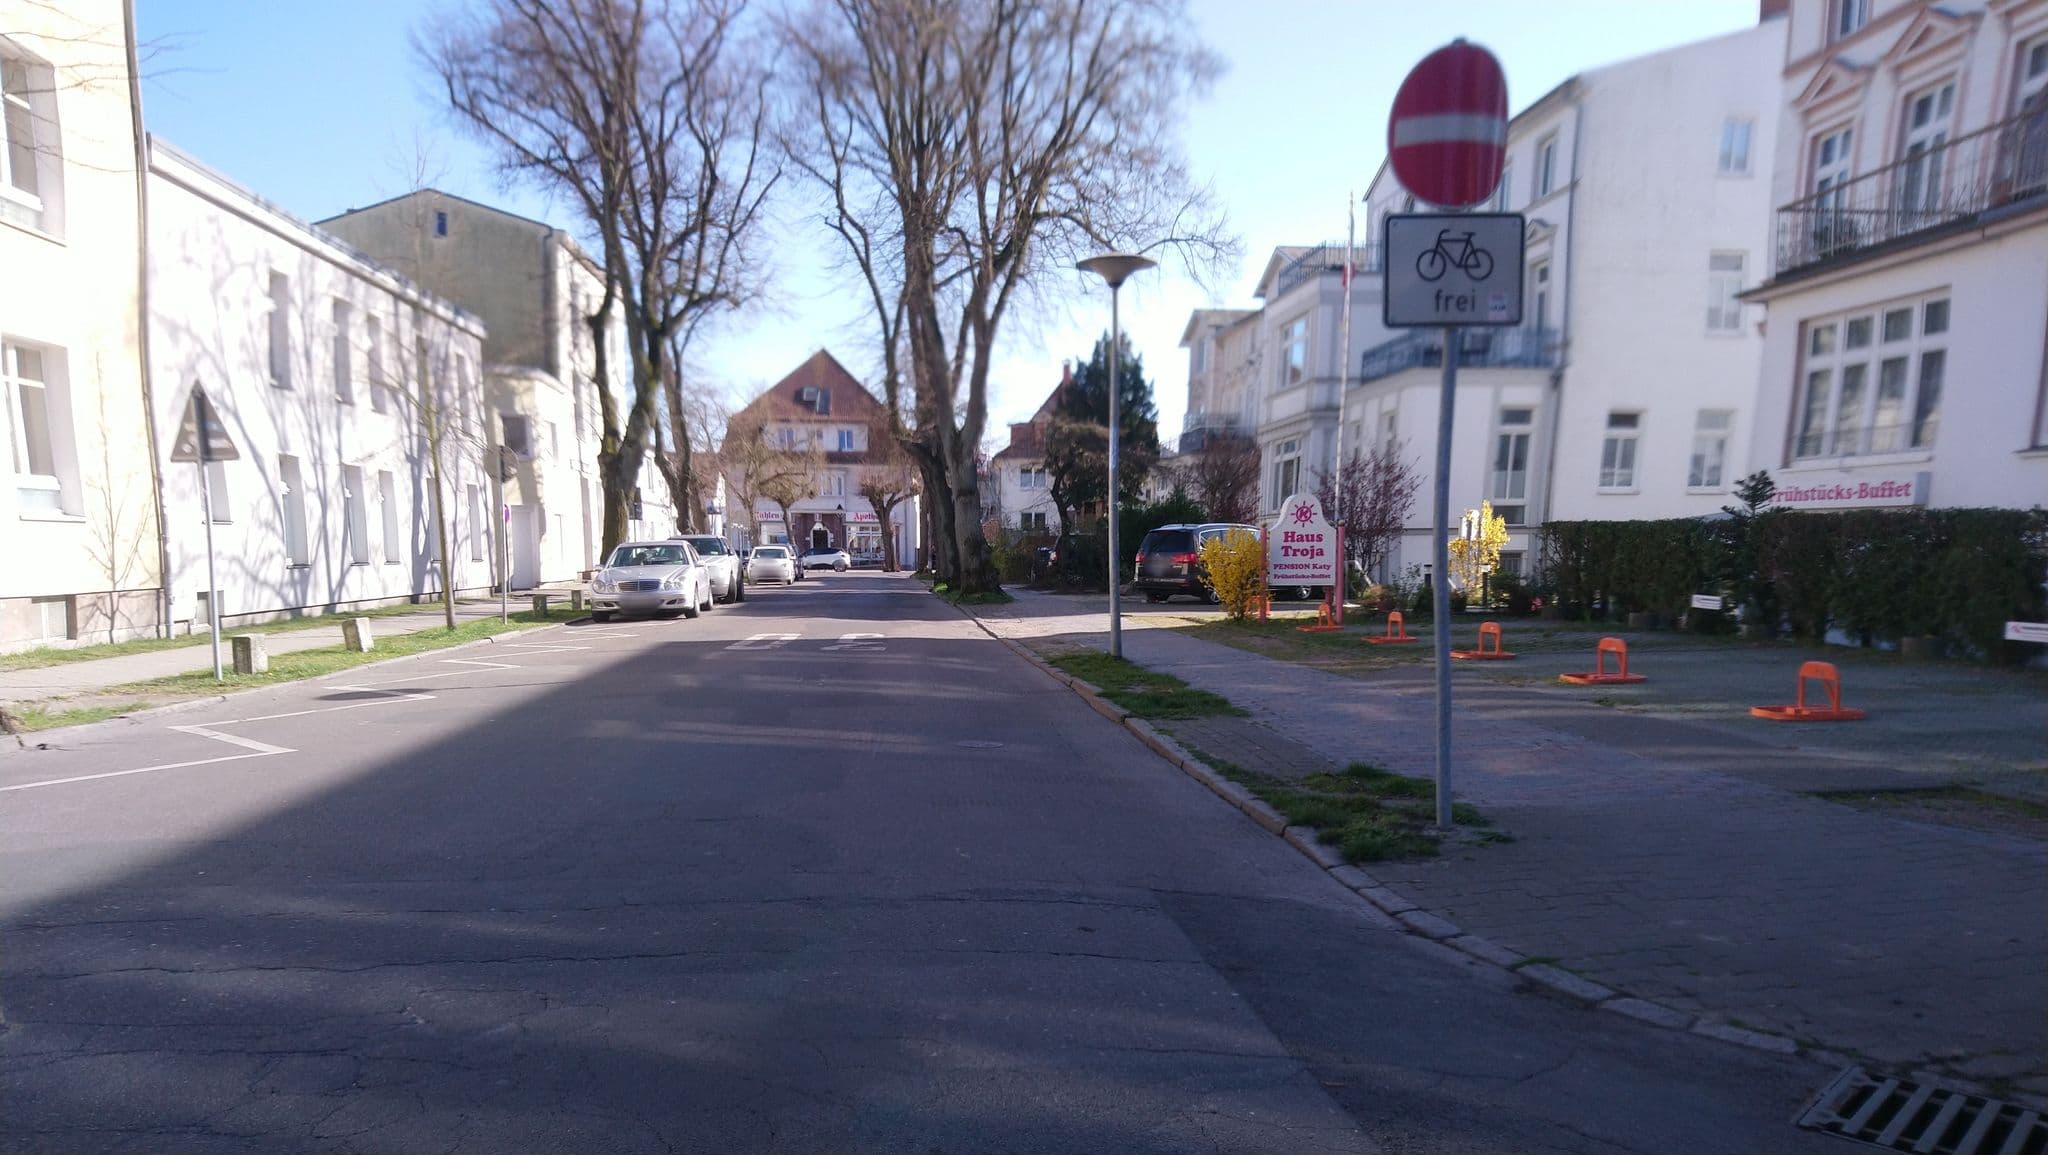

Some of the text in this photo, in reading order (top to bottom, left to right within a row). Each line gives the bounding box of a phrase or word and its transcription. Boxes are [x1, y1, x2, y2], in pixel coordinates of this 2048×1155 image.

[1435, 289, 1475, 311] frei
[1283, 532, 1323, 543] Haus
[1281, 546, 1325, 559] Troja
